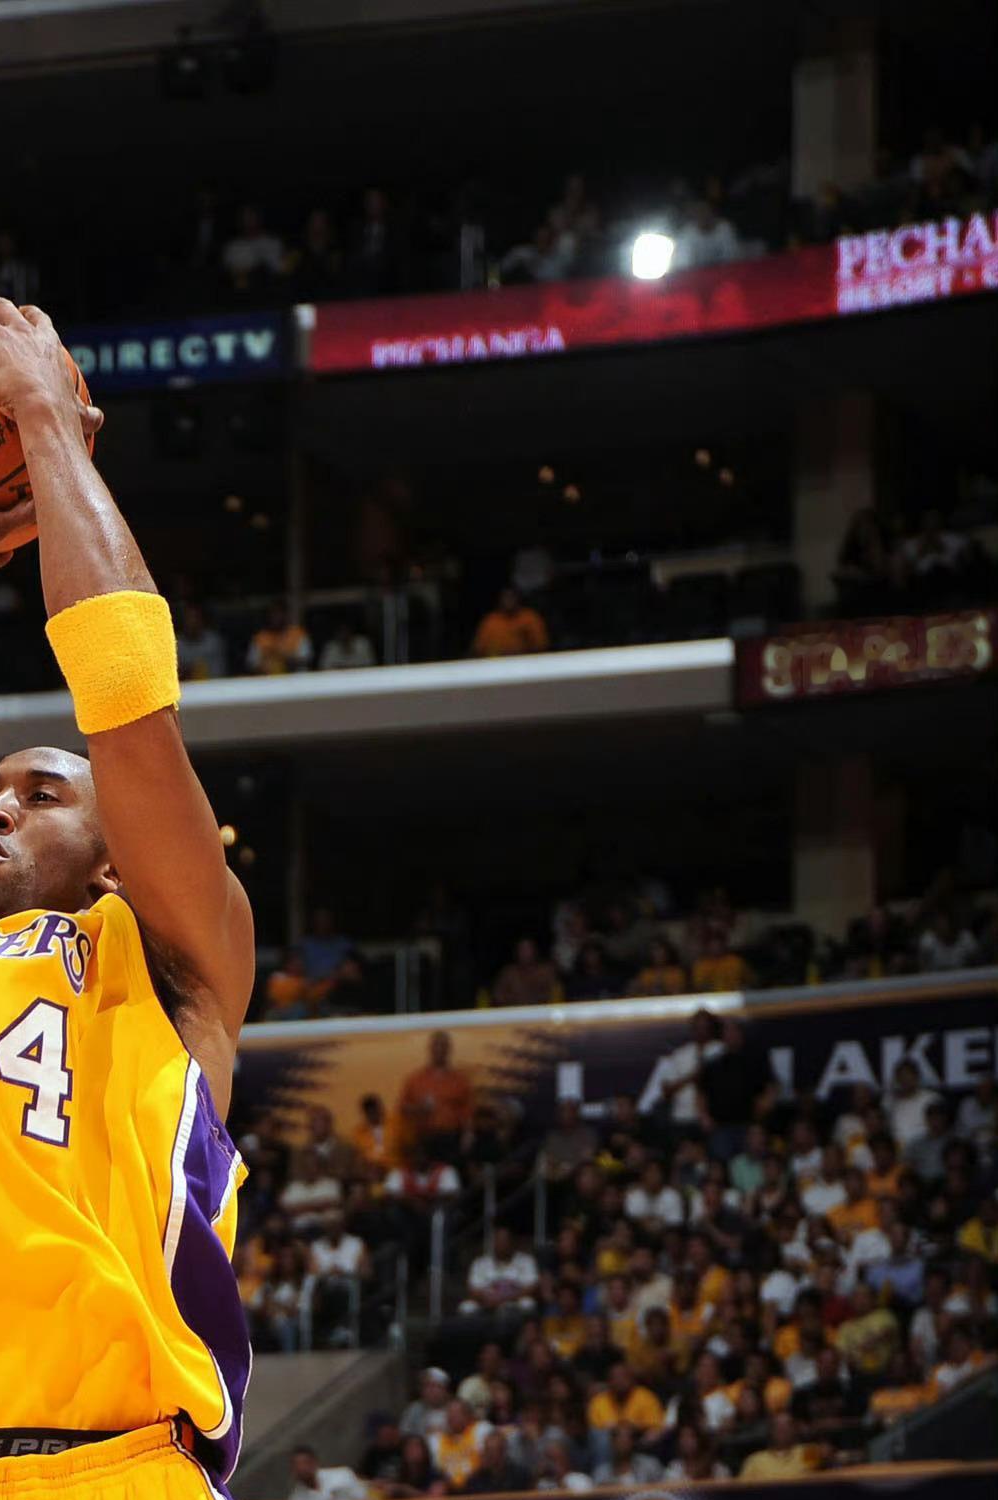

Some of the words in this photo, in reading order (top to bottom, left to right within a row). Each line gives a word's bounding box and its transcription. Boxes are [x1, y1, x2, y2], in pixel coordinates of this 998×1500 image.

[837, 211, 998, 279] PECHA
[69, 330, 274, 375] DIRECTV
[769, 1026, 998, 1101] AKE
[9, 1438, 94, 1455] PR
